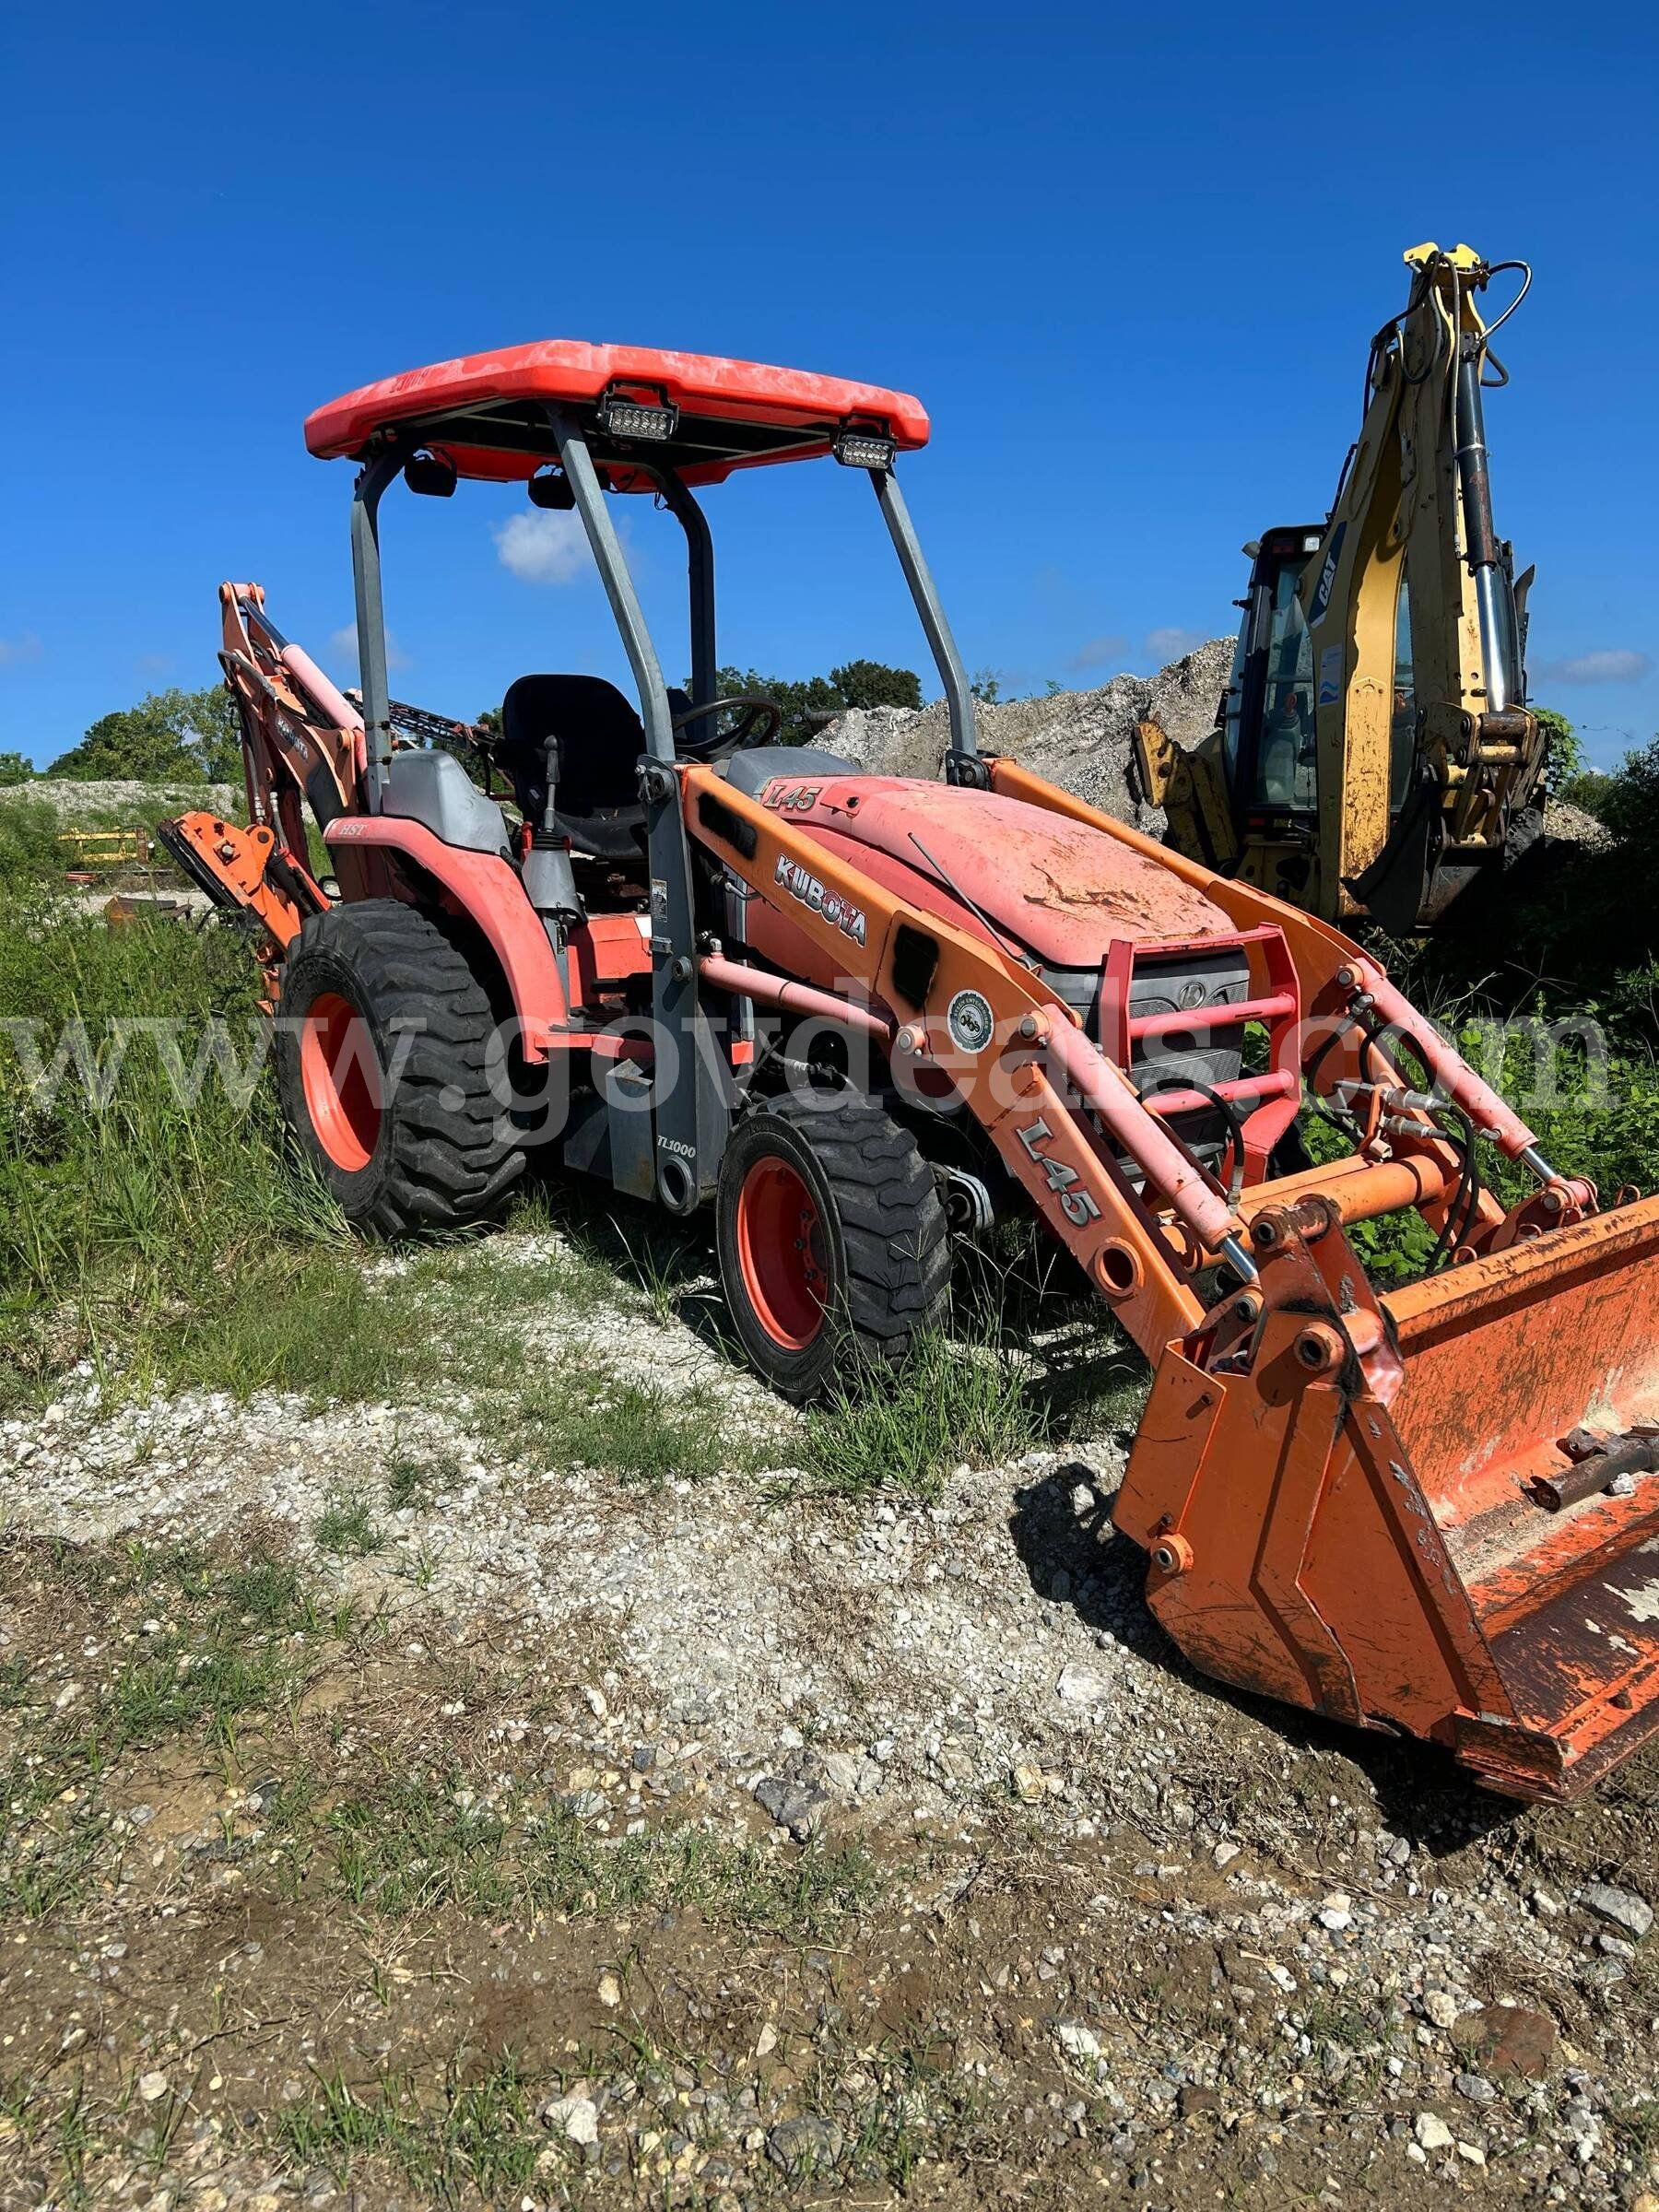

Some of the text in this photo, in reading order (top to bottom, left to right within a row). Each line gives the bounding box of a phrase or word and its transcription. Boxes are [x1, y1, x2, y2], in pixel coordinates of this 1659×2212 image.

[1318, 551, 1336, 607] CAT
[762, 785, 823, 811] L45
[338, 823, 368, 836] HST
[774, 853, 866, 947] KUBOTA
[657, 1135, 697, 1159] TL1000
[1015, 1115, 1102, 1227] L45
